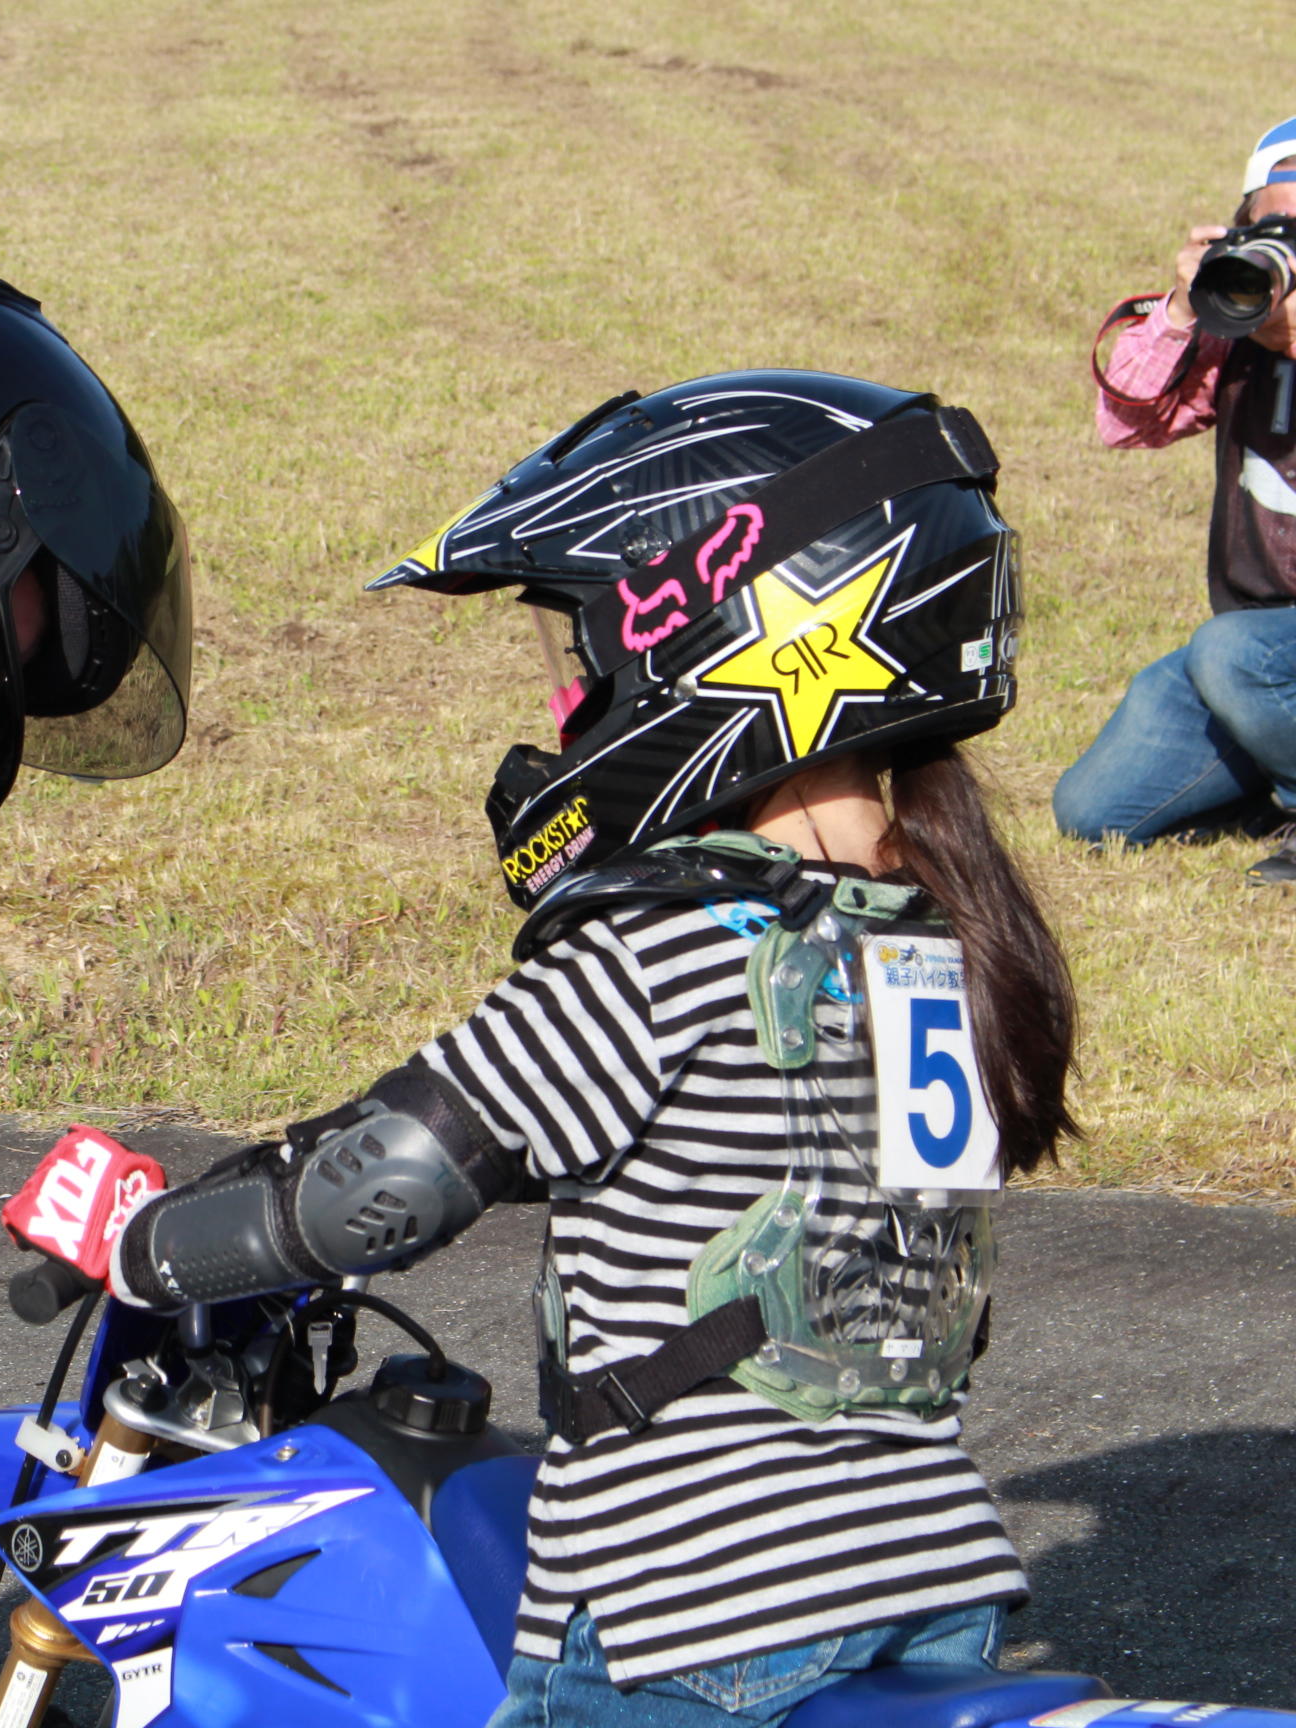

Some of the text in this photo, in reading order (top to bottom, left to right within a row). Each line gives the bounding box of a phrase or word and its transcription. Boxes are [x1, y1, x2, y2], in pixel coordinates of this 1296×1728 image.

[525, 825, 596, 893] ENERGY DRINK
[907, 997, 973, 1169] 5
[27, 1138, 112, 1261] FOX
[81, 1569, 176, 1607] 50
[121, 1662, 163, 1682] GYTR
